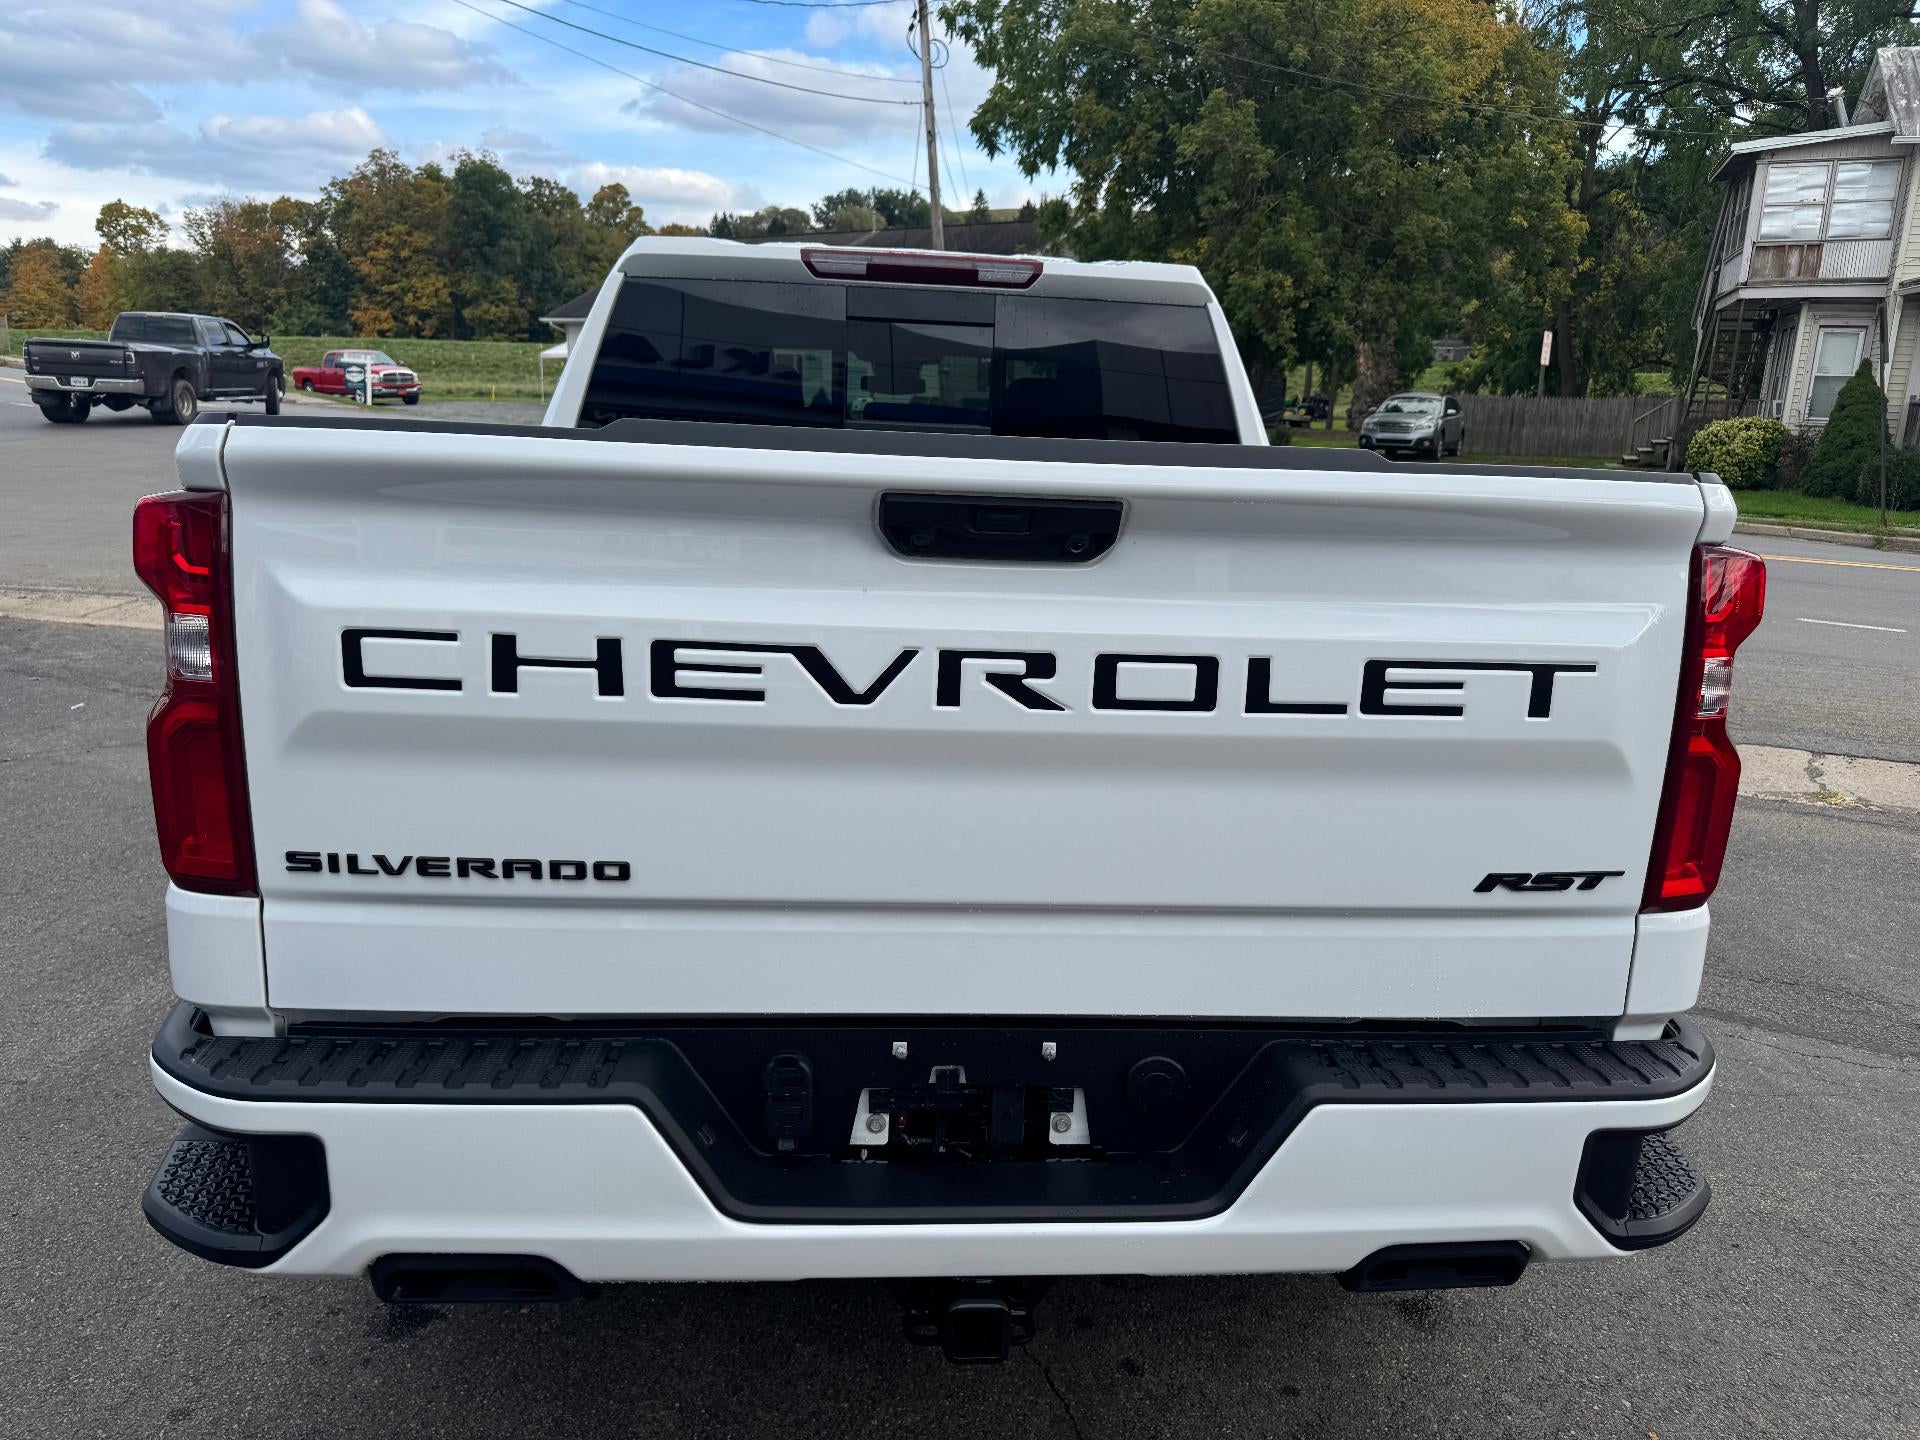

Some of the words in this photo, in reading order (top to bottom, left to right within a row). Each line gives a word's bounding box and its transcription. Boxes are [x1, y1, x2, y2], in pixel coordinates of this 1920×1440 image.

[341, 628, 1597, 718] CHEVROLET
[285, 850, 631, 881] SILVERADO
[1473, 870, 1626, 892] RST
